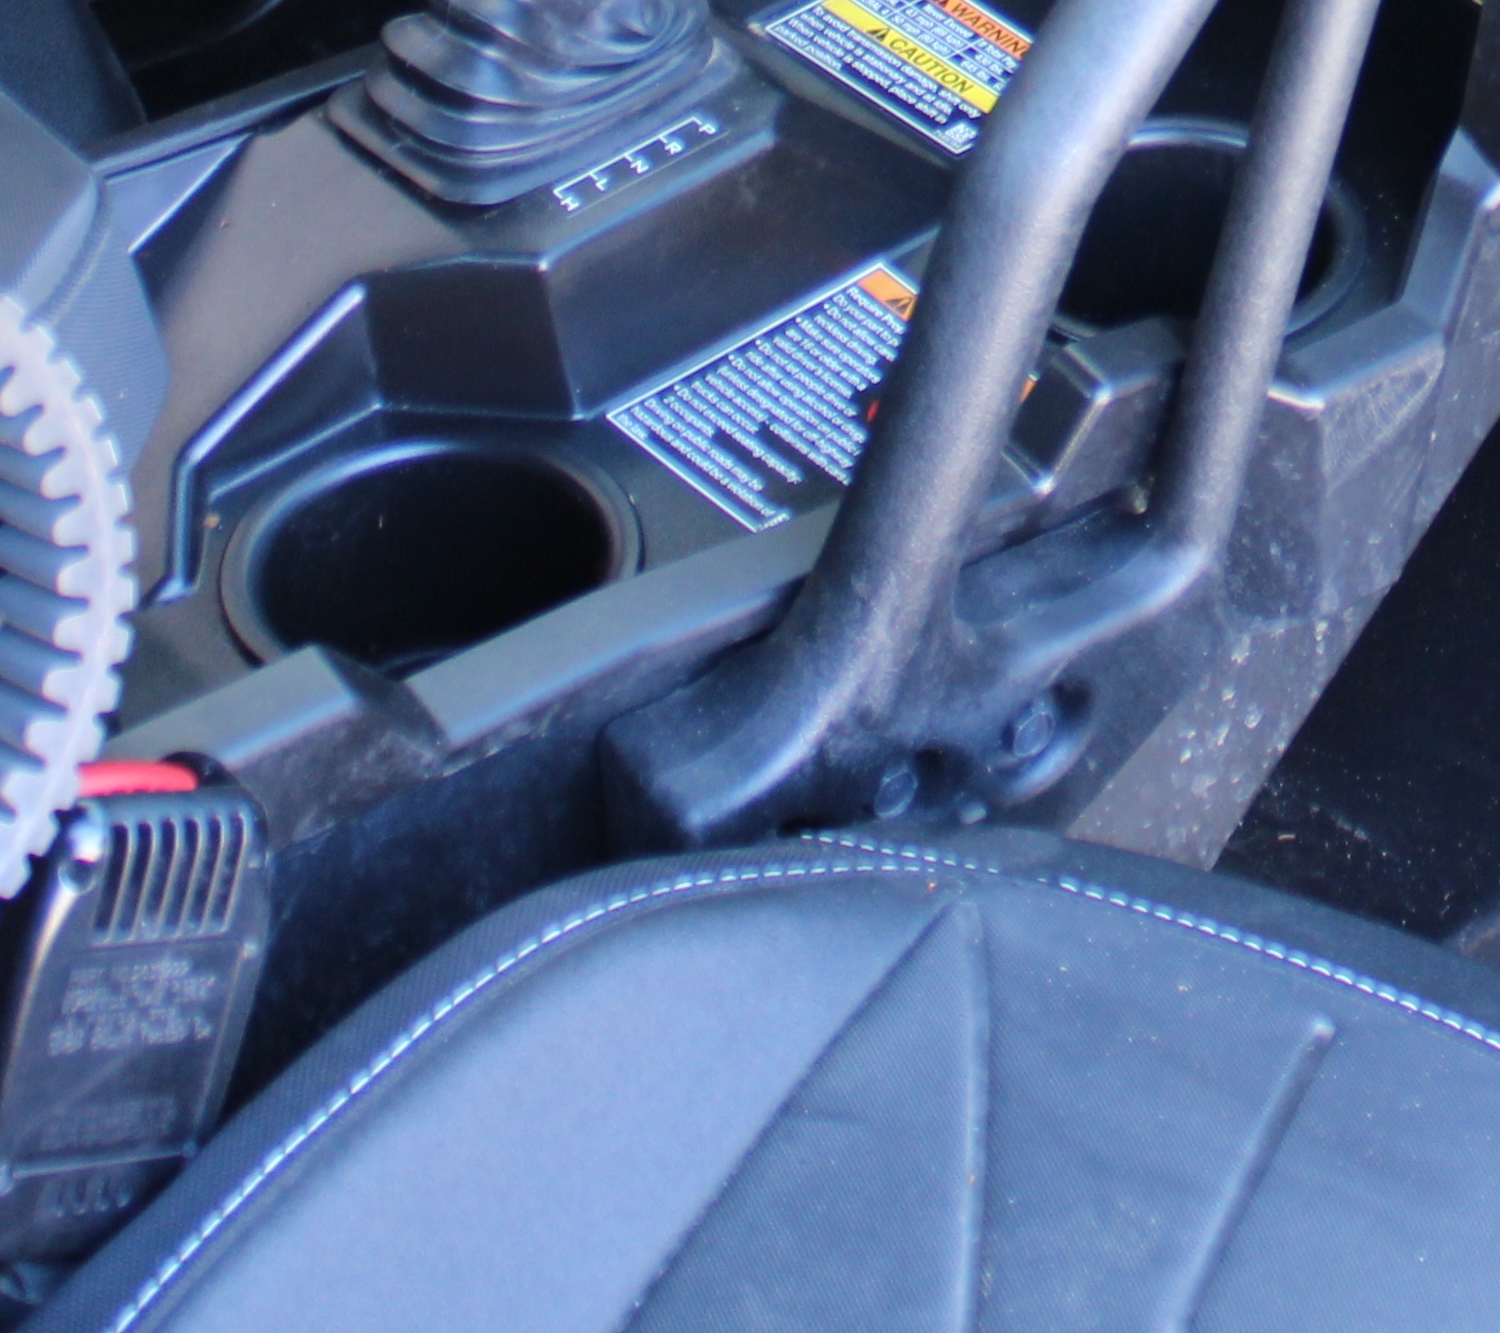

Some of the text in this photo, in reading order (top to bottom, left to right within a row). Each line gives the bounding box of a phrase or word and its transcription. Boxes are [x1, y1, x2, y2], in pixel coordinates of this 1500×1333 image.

[819, 12, 852, 33] avoid
[844, 28, 905, 68] transmission
[820, 27, 858, 51] vehicle
[951, 2, 1028, 58] WARNIN
[810, 33, 848, 58] vehicle
[889, 39, 975, 94] CAUTION
[698, 123, 717, 135] P
[664, 140, 683, 155] R
[629, 159, 650, 175] N
[594, 177, 608, 192] L
[559, 195, 581, 212] H
[843, 285, 885, 320] Require
[640, 397, 679, 426] Driving
